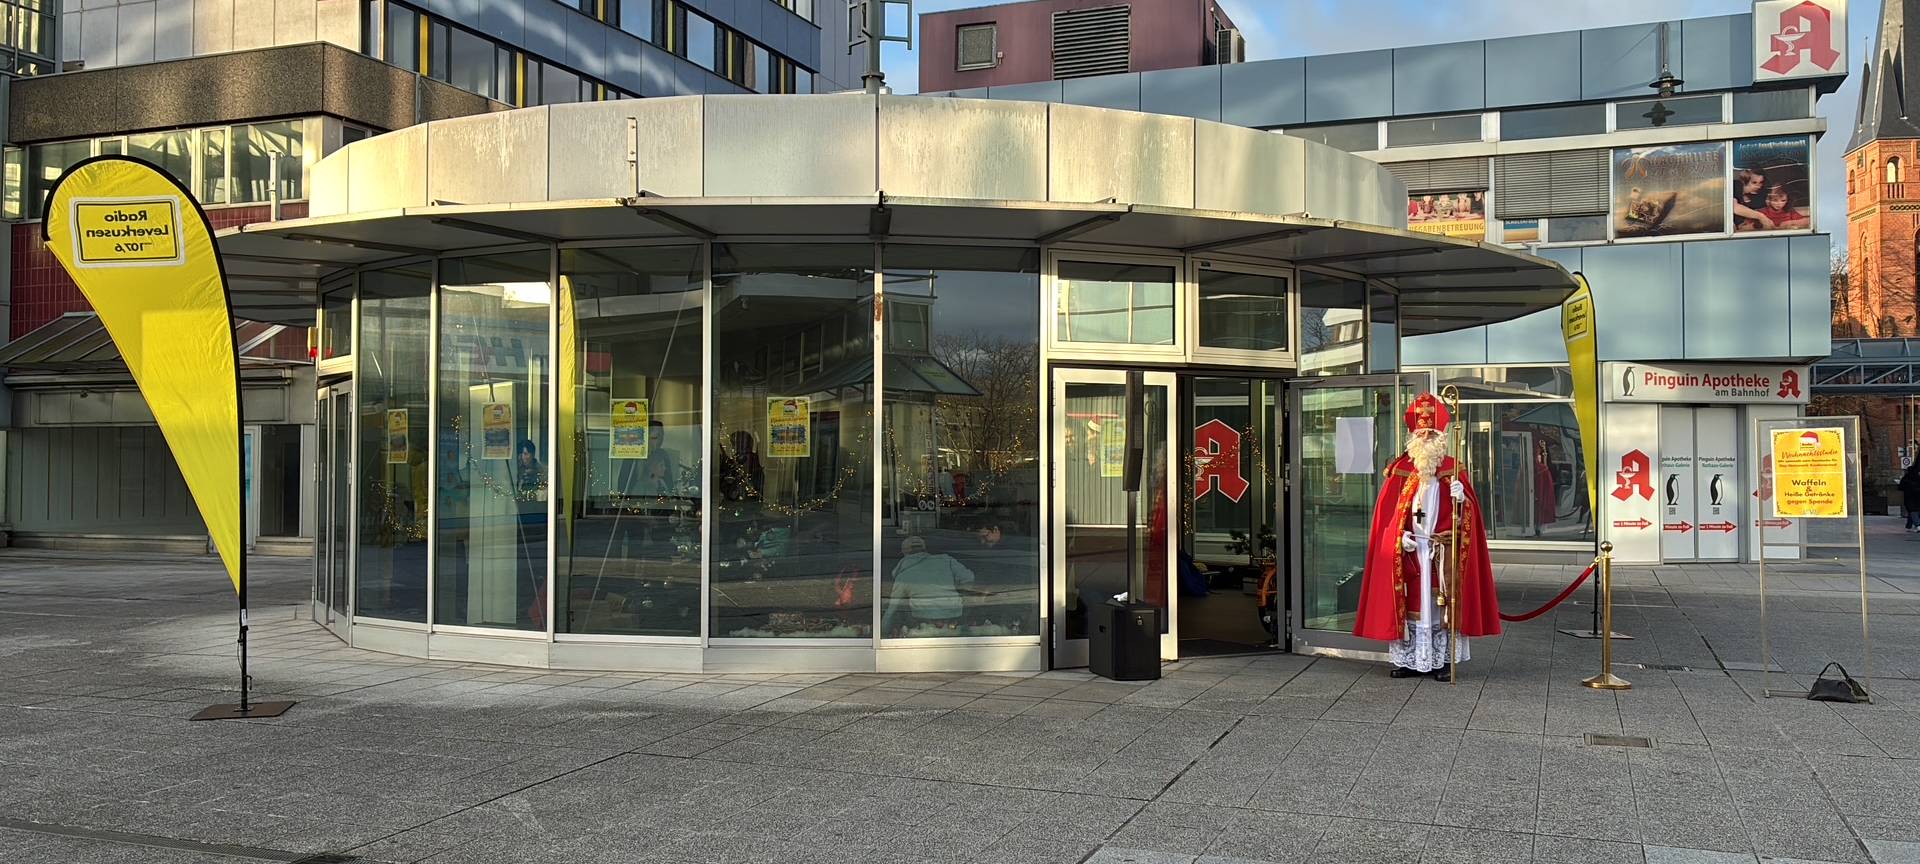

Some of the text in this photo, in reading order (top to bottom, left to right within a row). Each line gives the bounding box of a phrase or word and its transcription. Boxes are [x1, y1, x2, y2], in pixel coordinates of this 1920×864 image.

[1644, 372, 1699, 389] Pinguin
[1702, 374, 1770, 389] Apotheke
[1715, 388, 1770, 397] am Bahnhof
